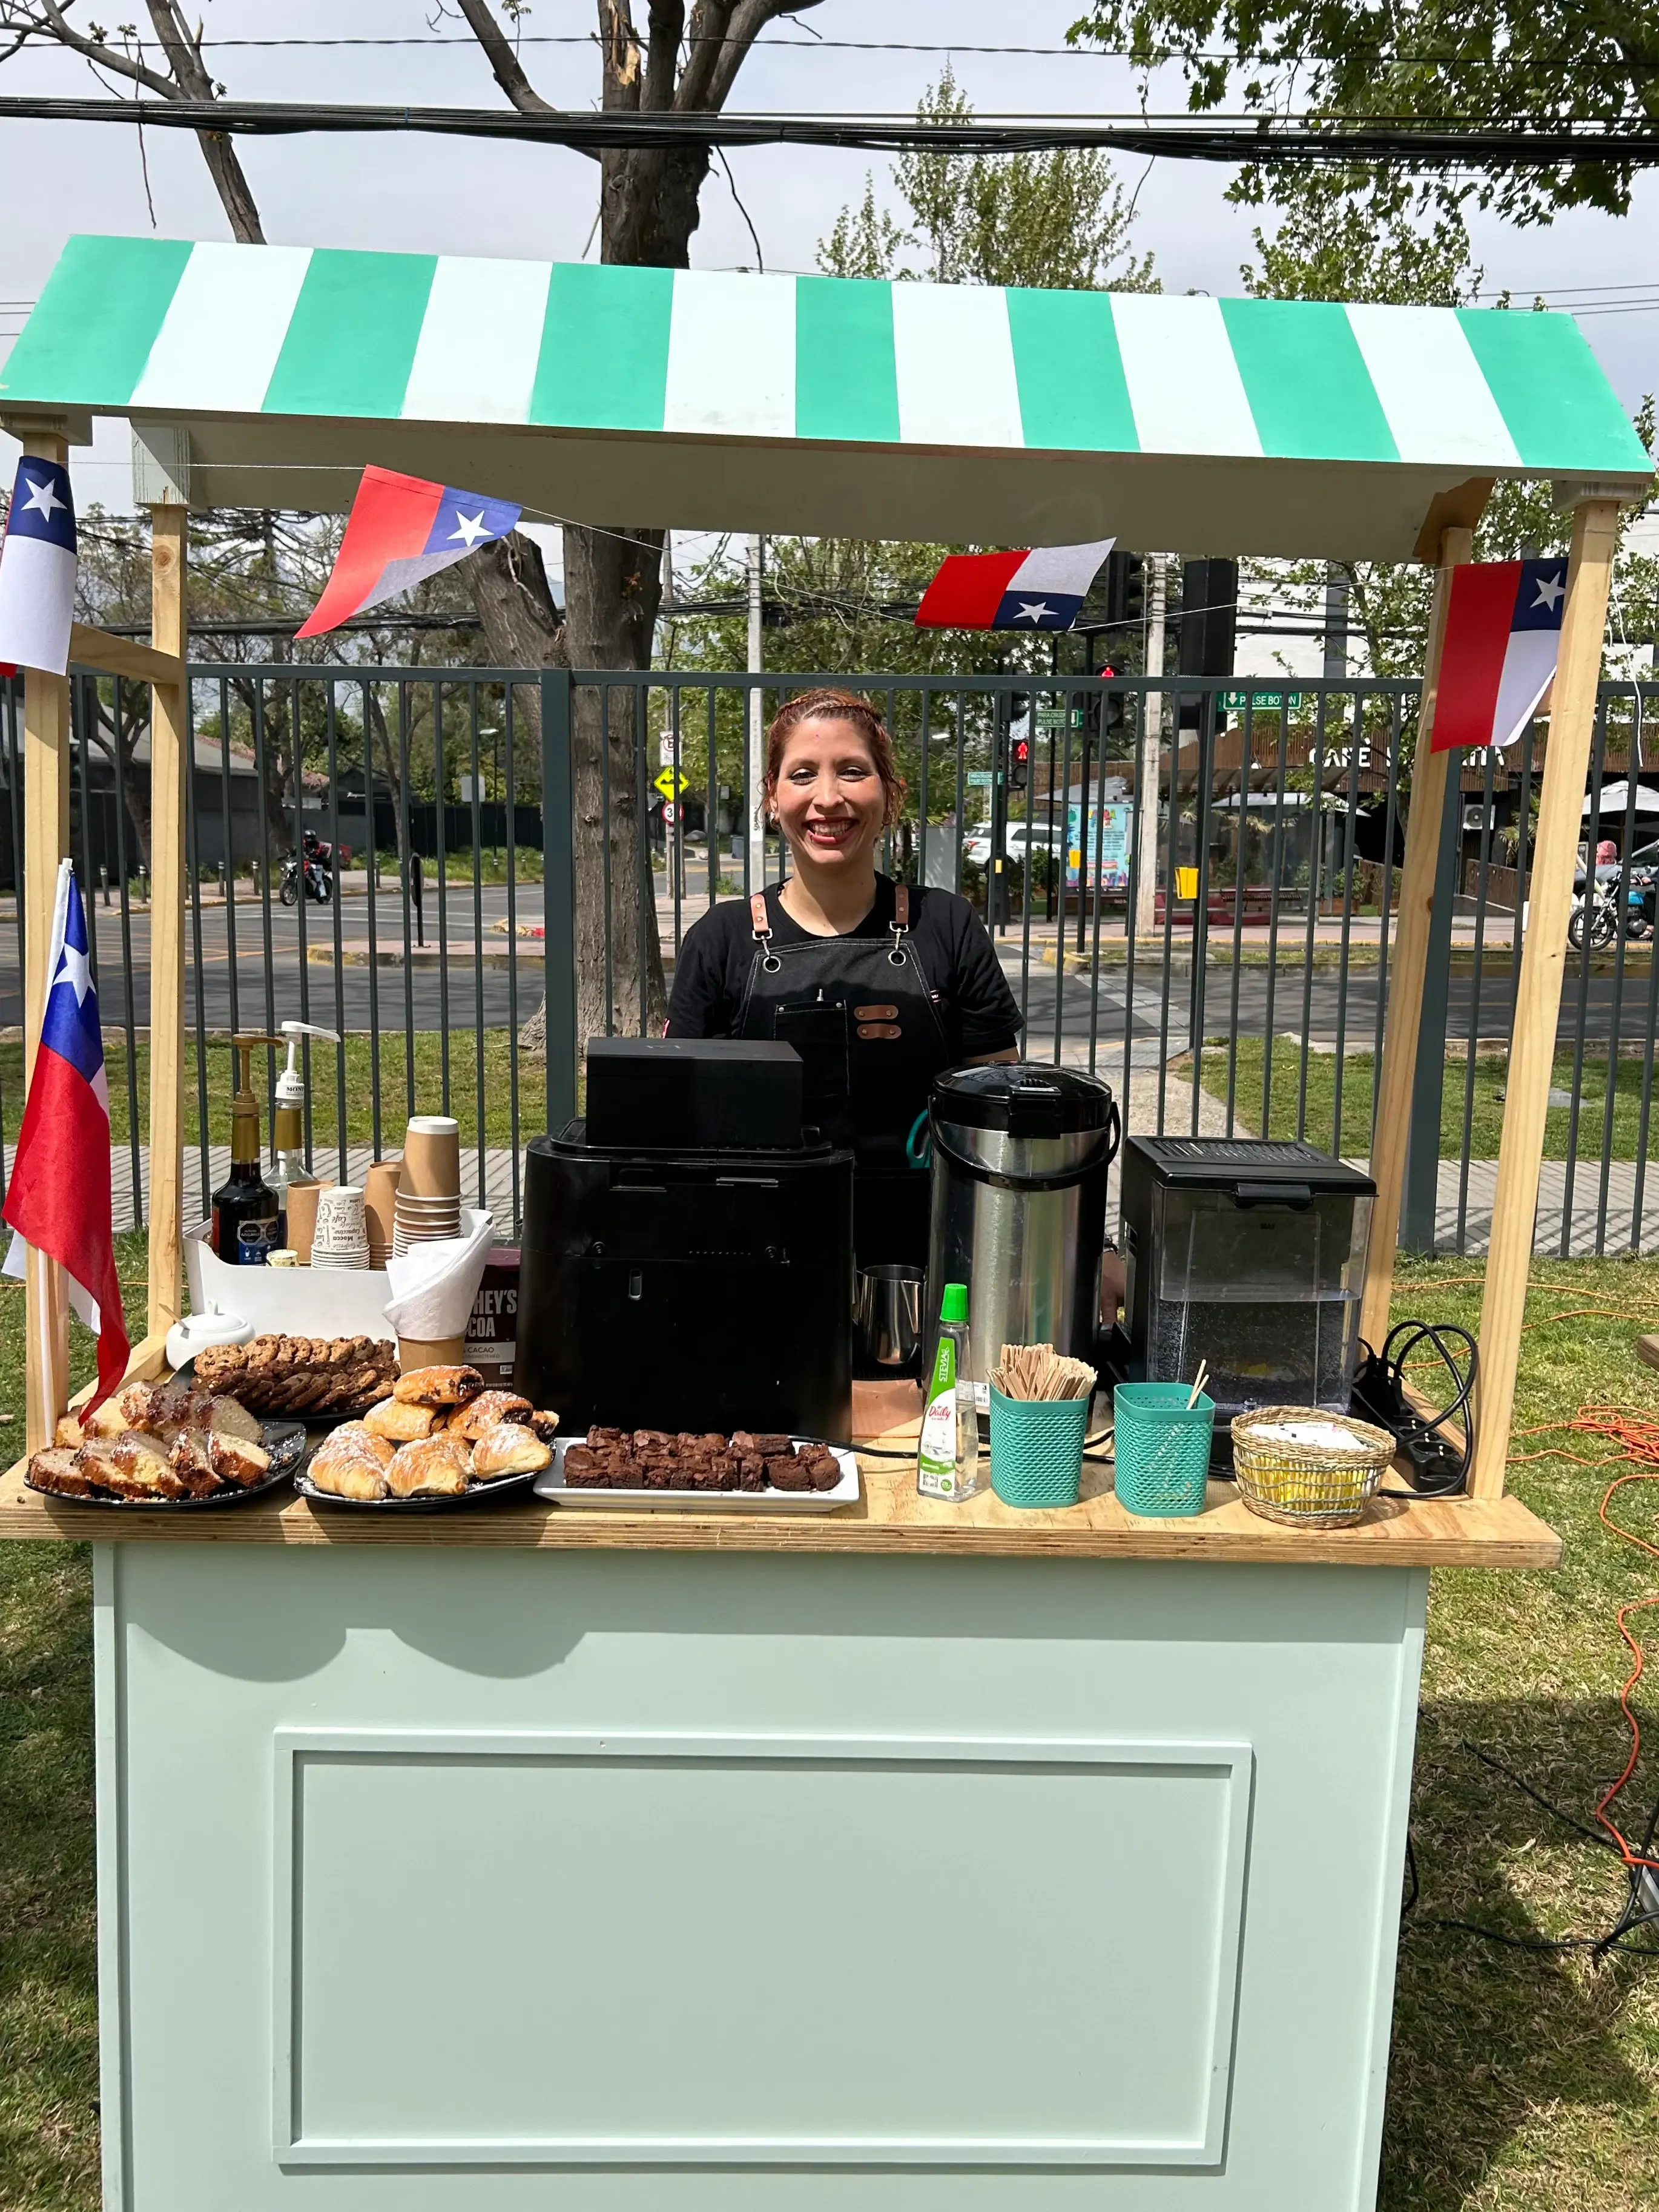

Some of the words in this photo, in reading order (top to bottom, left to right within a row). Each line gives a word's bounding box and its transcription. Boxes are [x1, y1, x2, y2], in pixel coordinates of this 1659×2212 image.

[1239, 696, 1266, 705] PLSE
[1268, 696, 1296, 705] BON
[473, 1289, 518, 1315] HEY'S
[467, 1317, 496, 1338] COA
[929, 1406, 951, 1421] Daily
